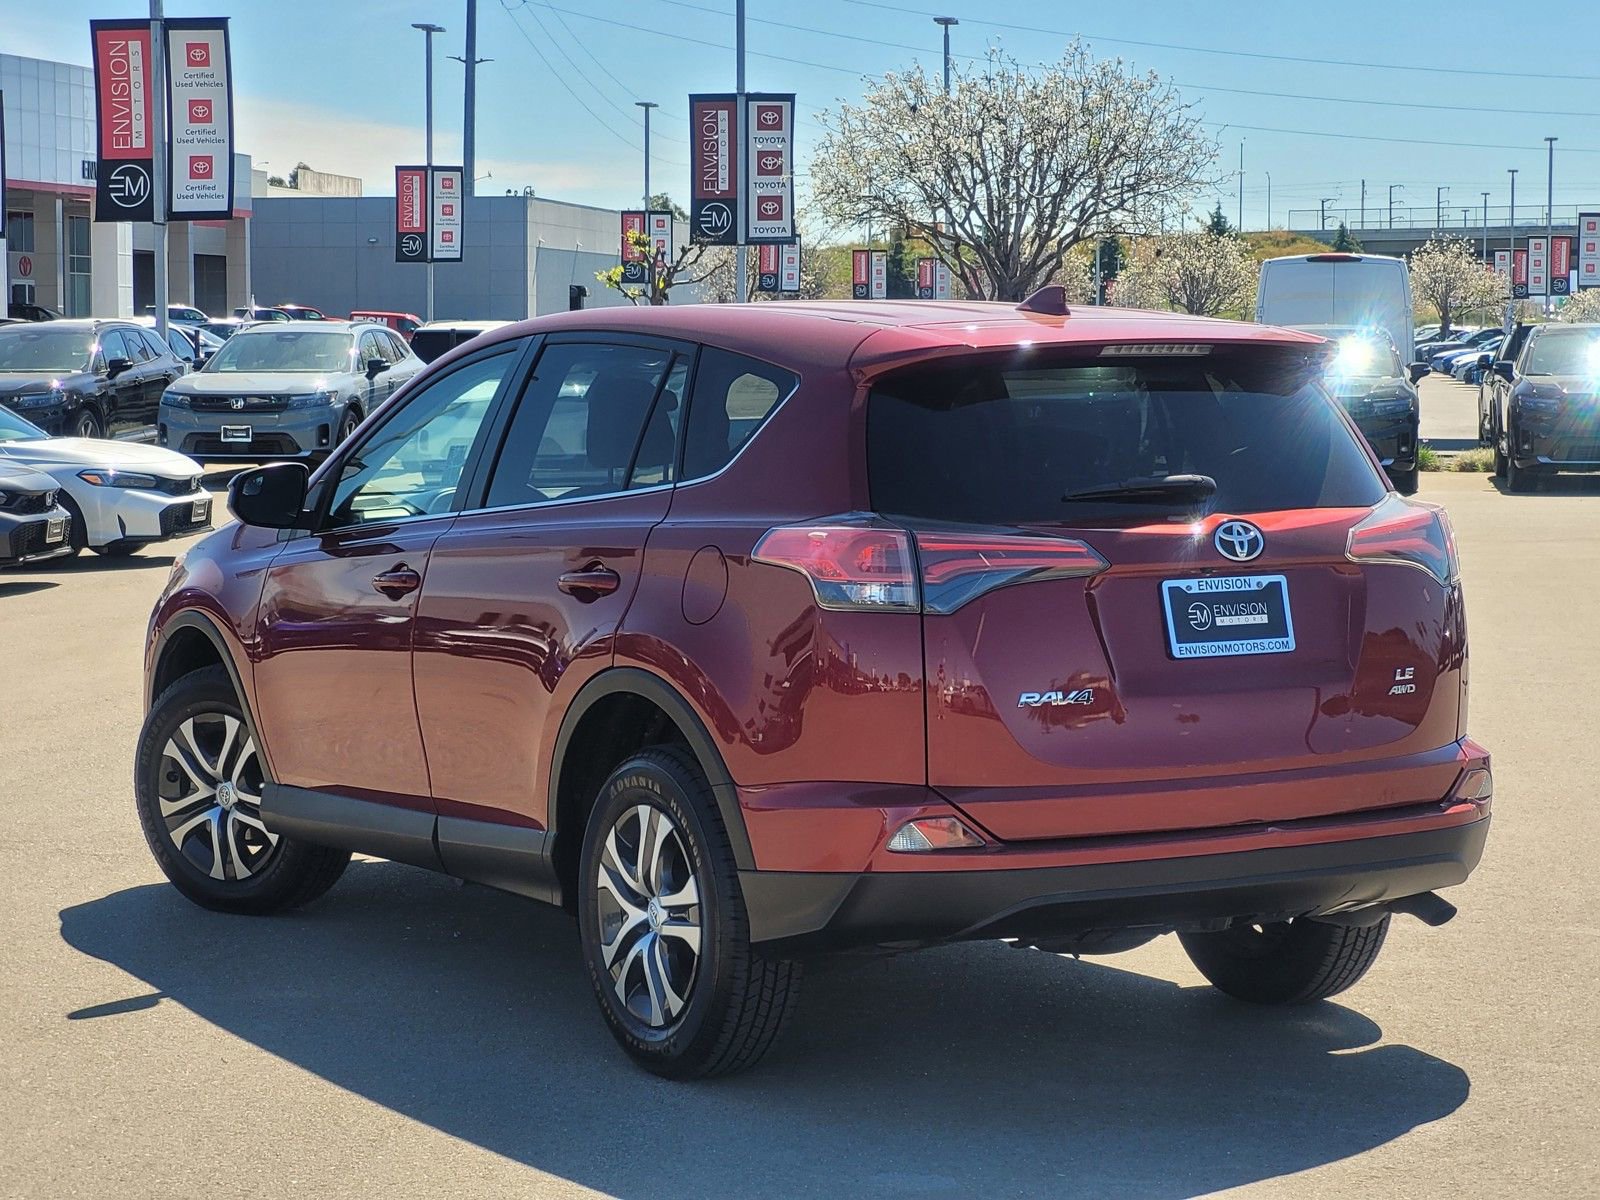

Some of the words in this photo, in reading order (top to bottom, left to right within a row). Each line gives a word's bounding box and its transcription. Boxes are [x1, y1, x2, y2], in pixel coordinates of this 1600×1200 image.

[108, 40, 131, 149] ENVISION
[131, 50, 143, 140] MOTORS
[185, 128, 217, 136] Certified
[753, 136, 786, 144] TOYOTA
[703, 110, 718, 191] ENVISION
[753, 181, 786, 189] TOYOTA
[403, 175, 413, 228] ENVISION
[753, 226, 787, 234] TOYOTA
[1197, 578, 1252, 590] ENVISION
[1213, 602, 1267, 617] ENVISION
[1219, 616, 1264, 624] MOTORS
[1178, 640, 1290, 656] ENVISIONMOTORS.COM
[1395, 667, 1414, 680] LE
[1388, 683, 1416, 695] AWD
[1017, 688, 1094, 707] RAV4
